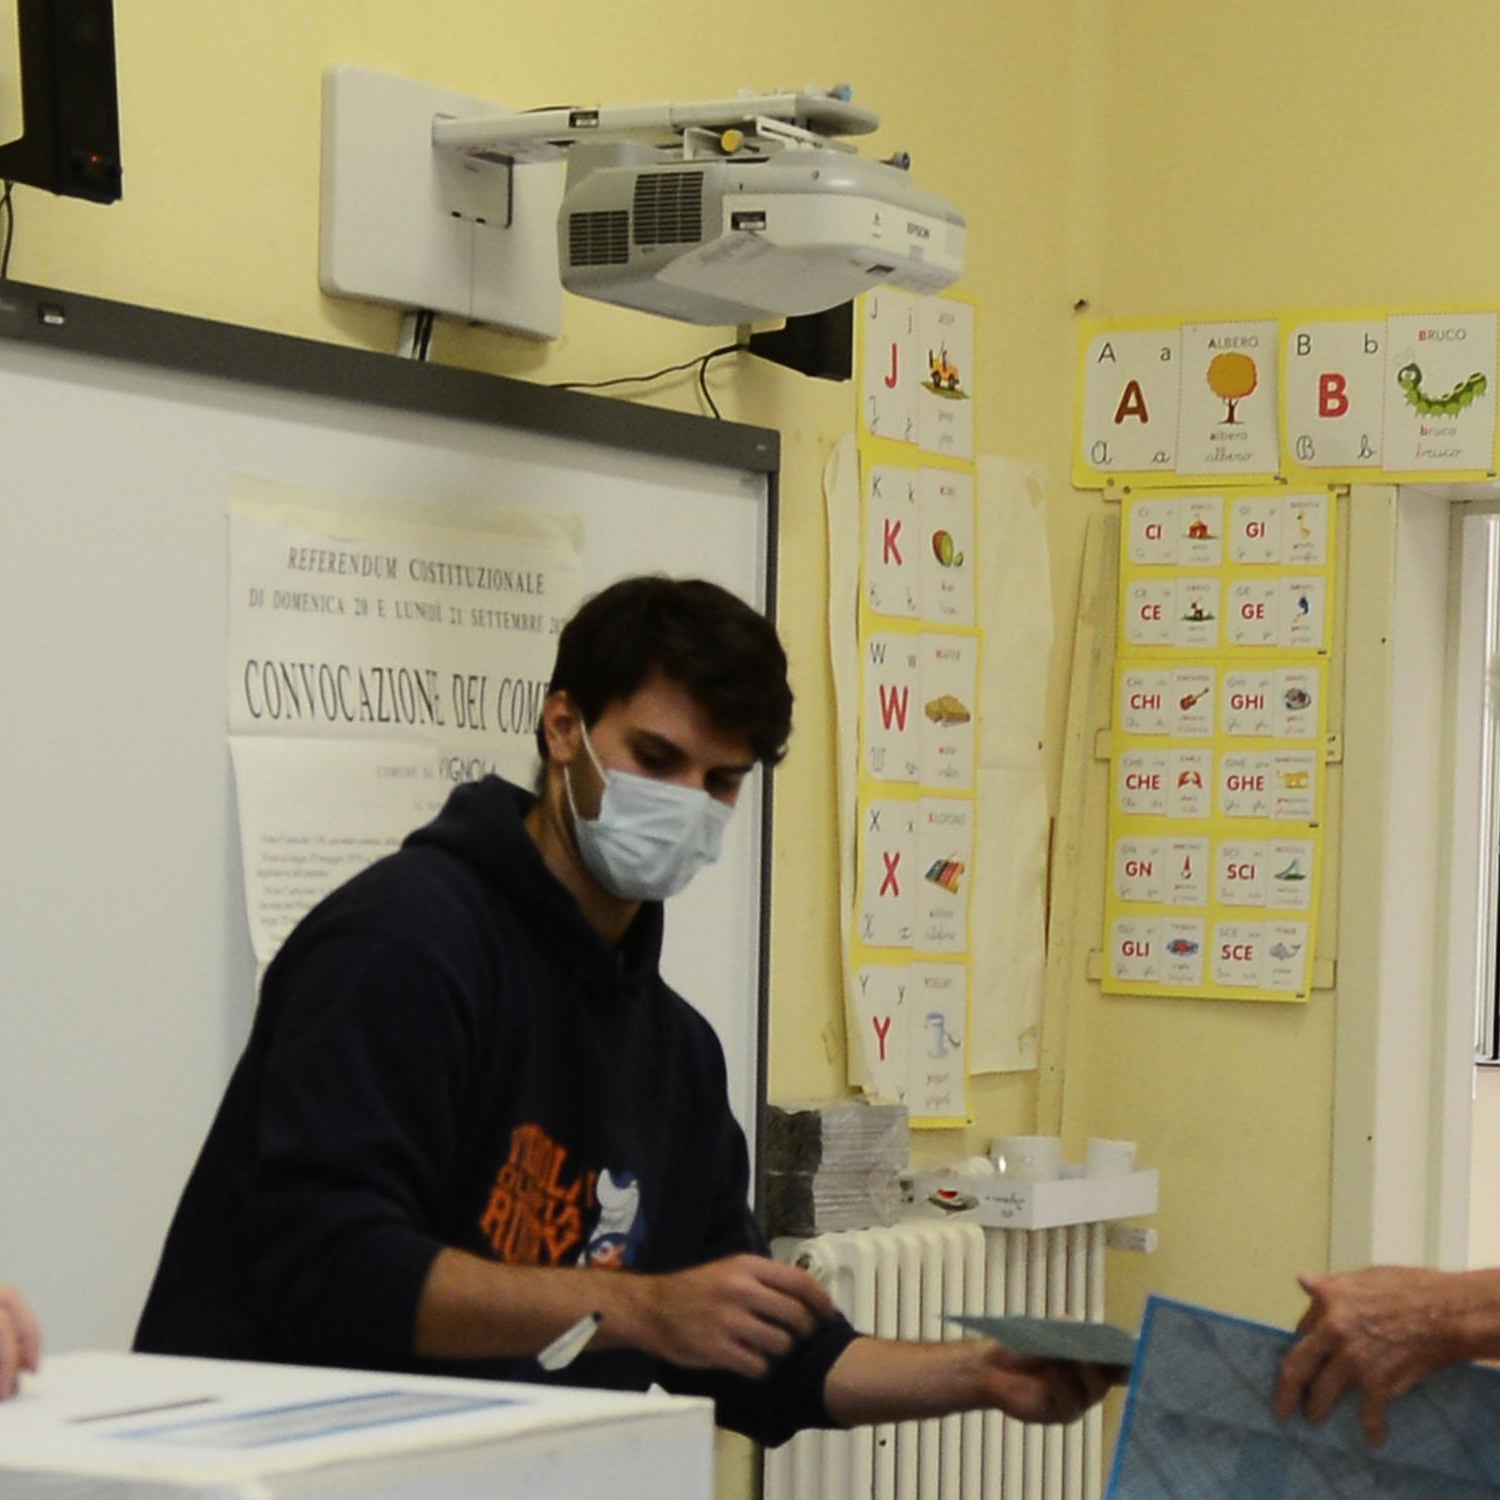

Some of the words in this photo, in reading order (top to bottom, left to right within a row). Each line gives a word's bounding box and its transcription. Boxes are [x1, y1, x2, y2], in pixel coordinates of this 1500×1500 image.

[870, 298, 878, 319] J
[1208, 336, 1259, 349] ALBERO
[1297, 333, 1311, 356] B
[1364, 333, 1378, 354] b
[1419, 329, 1466, 341] BRUCO
[1098, 342, 1116, 363] A
[1160, 347, 1171, 361] a
[885, 343, 897, 389] J
[1115, 380, 1148, 424] A
[1318, 373, 1349, 418] B
[1420, 425, 1456, 436] bruco
[872, 475, 882, 498] K
[908, 482, 914, 503] k
[1145, 524, 1162, 540] CI
[1246, 522, 1265, 538] GI
[884, 518, 902, 565] K
[287, 546, 397, 580] REFERENDUM
[409, 557, 546, 595] COSTITUZIONALE
[249, 587, 264, 608] DI
[273, 589, 345, 615] DOMENICA
[377, 599, 386, 618] E
[470, 608, 543, 633] SETTEMBRE
[1141, 605, 1161, 620] CE
[1241, 603, 1265, 620] GE
[871, 642, 886, 664] W
[244, 659, 445, 727] CONVOCAZIONE
[452, 673, 487, 731] DEI
[1130, 694, 1160, 710] CHI
[1230, 694, 1264, 710] GHI
[879, 684, 908, 731] W
[1125, 774, 1161, 790] CHE
[1227, 775, 1264, 791] GHE
[870, 809, 881, 832] X
[880, 852, 900, 896] X
[1125, 861, 1152, 877] GN
[1227, 864, 1255, 880] SCI
[1122, 941, 1149, 957] GLI
[1221, 944, 1253, 961] SCE
[859, 975, 869, 996] Y
[898, 985, 905, 1004] y
[872, 1016, 891, 1061] Y
